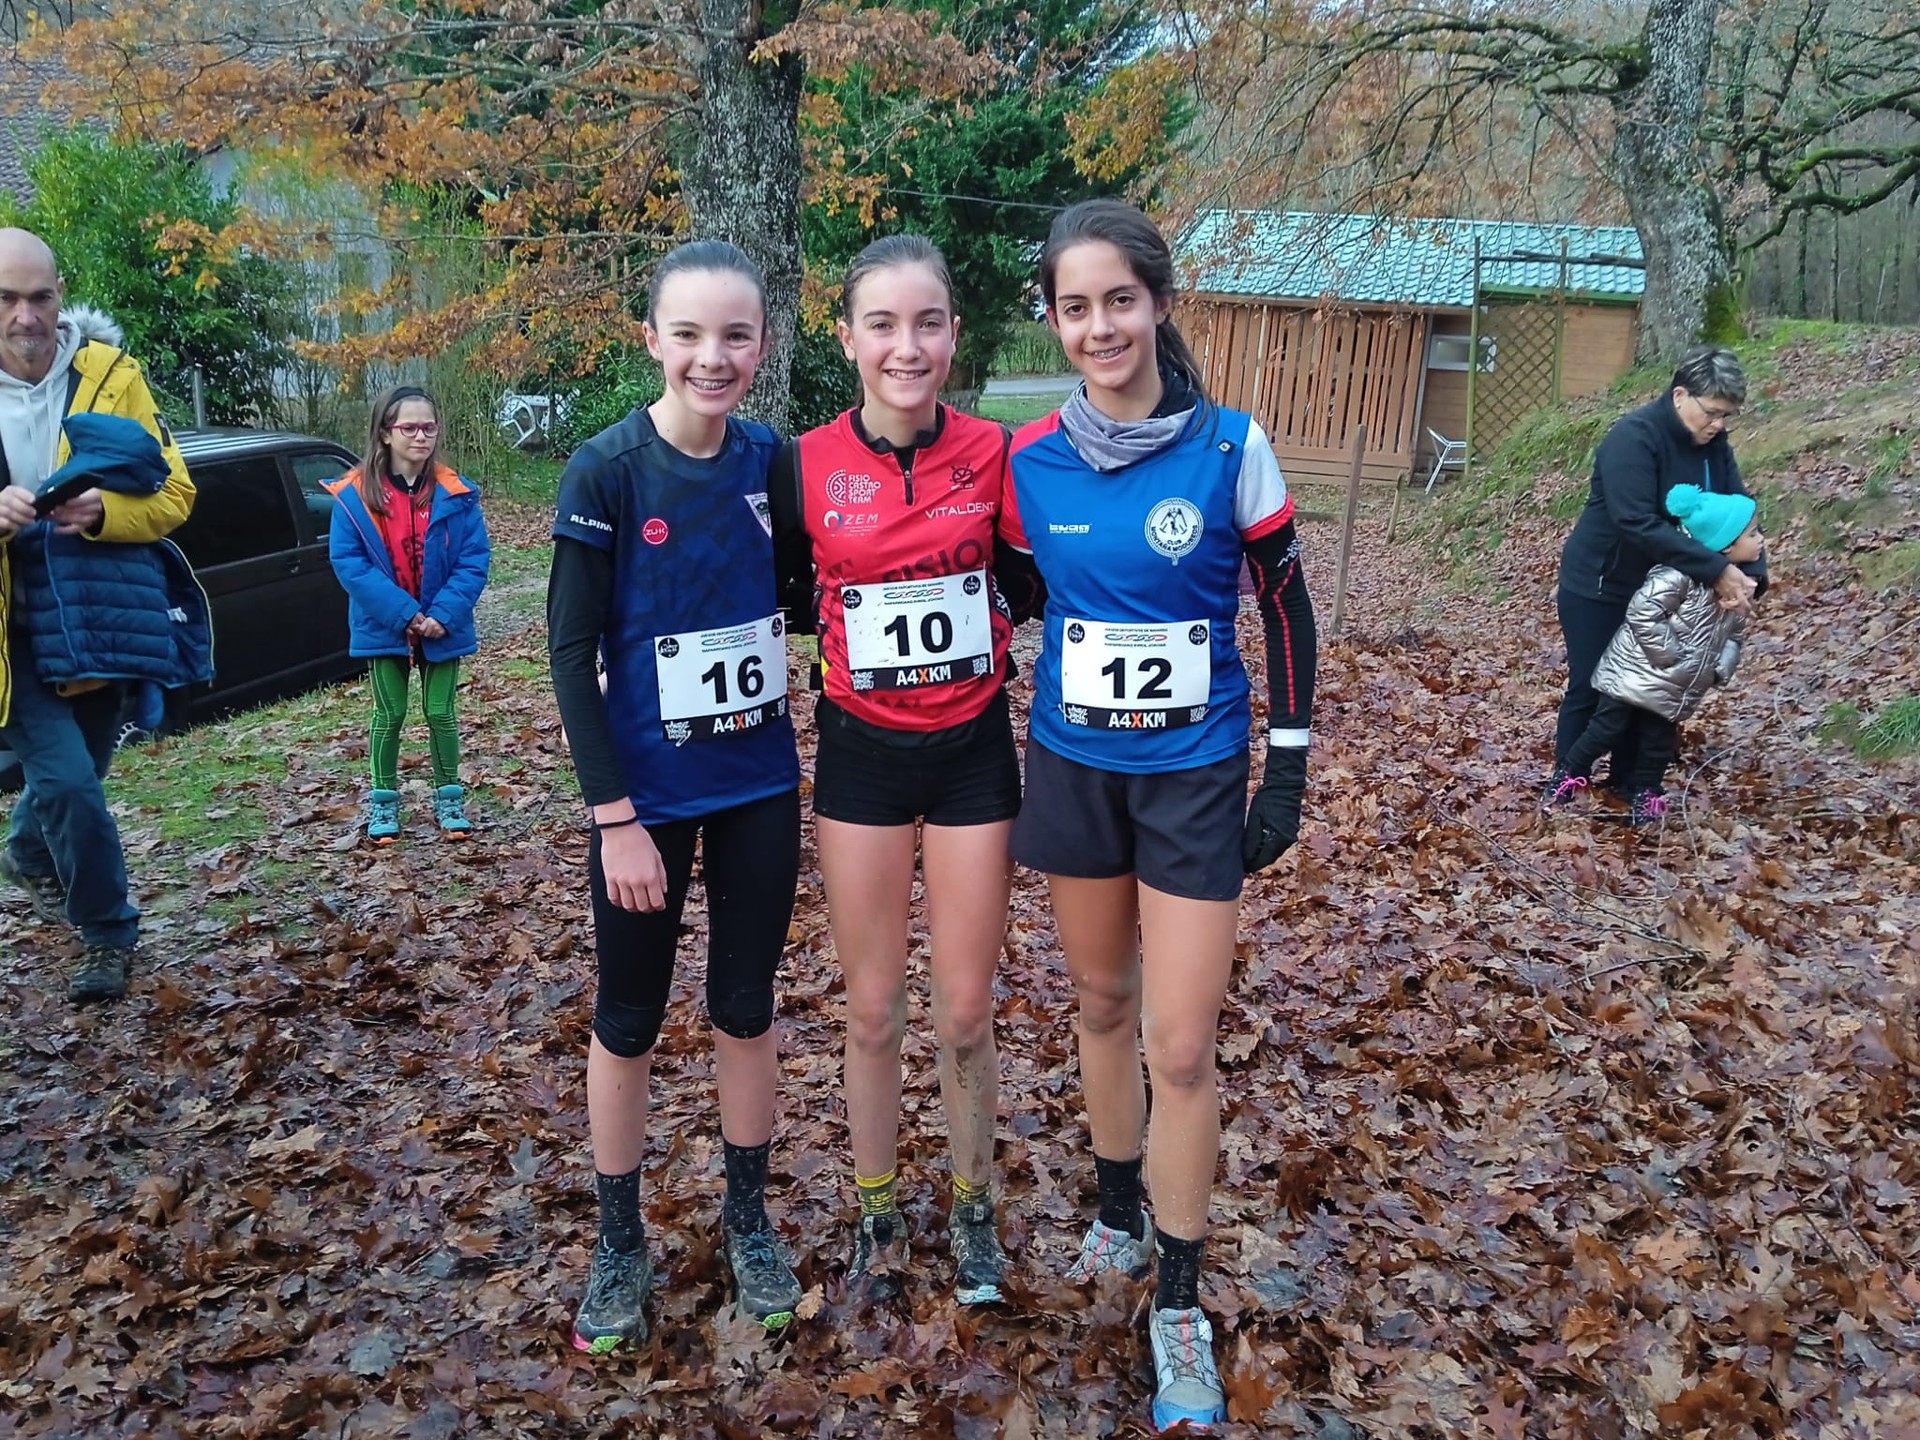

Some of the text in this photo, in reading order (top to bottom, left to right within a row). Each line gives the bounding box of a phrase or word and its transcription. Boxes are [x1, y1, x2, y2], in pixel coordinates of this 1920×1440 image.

[848, 474, 870, 482] FISIO
[844, 513, 879, 525] ZEM
[925, 502, 995, 519] VITALDENT
[884, 611, 953, 657] 10
[701, 655, 764, 704] 16
[896, 664, 952, 686] A4XKM
[1101, 657, 1172, 699] 12
[713, 708, 763, 734] A4XKM
[1108, 712, 1167, 728] A4XKM
